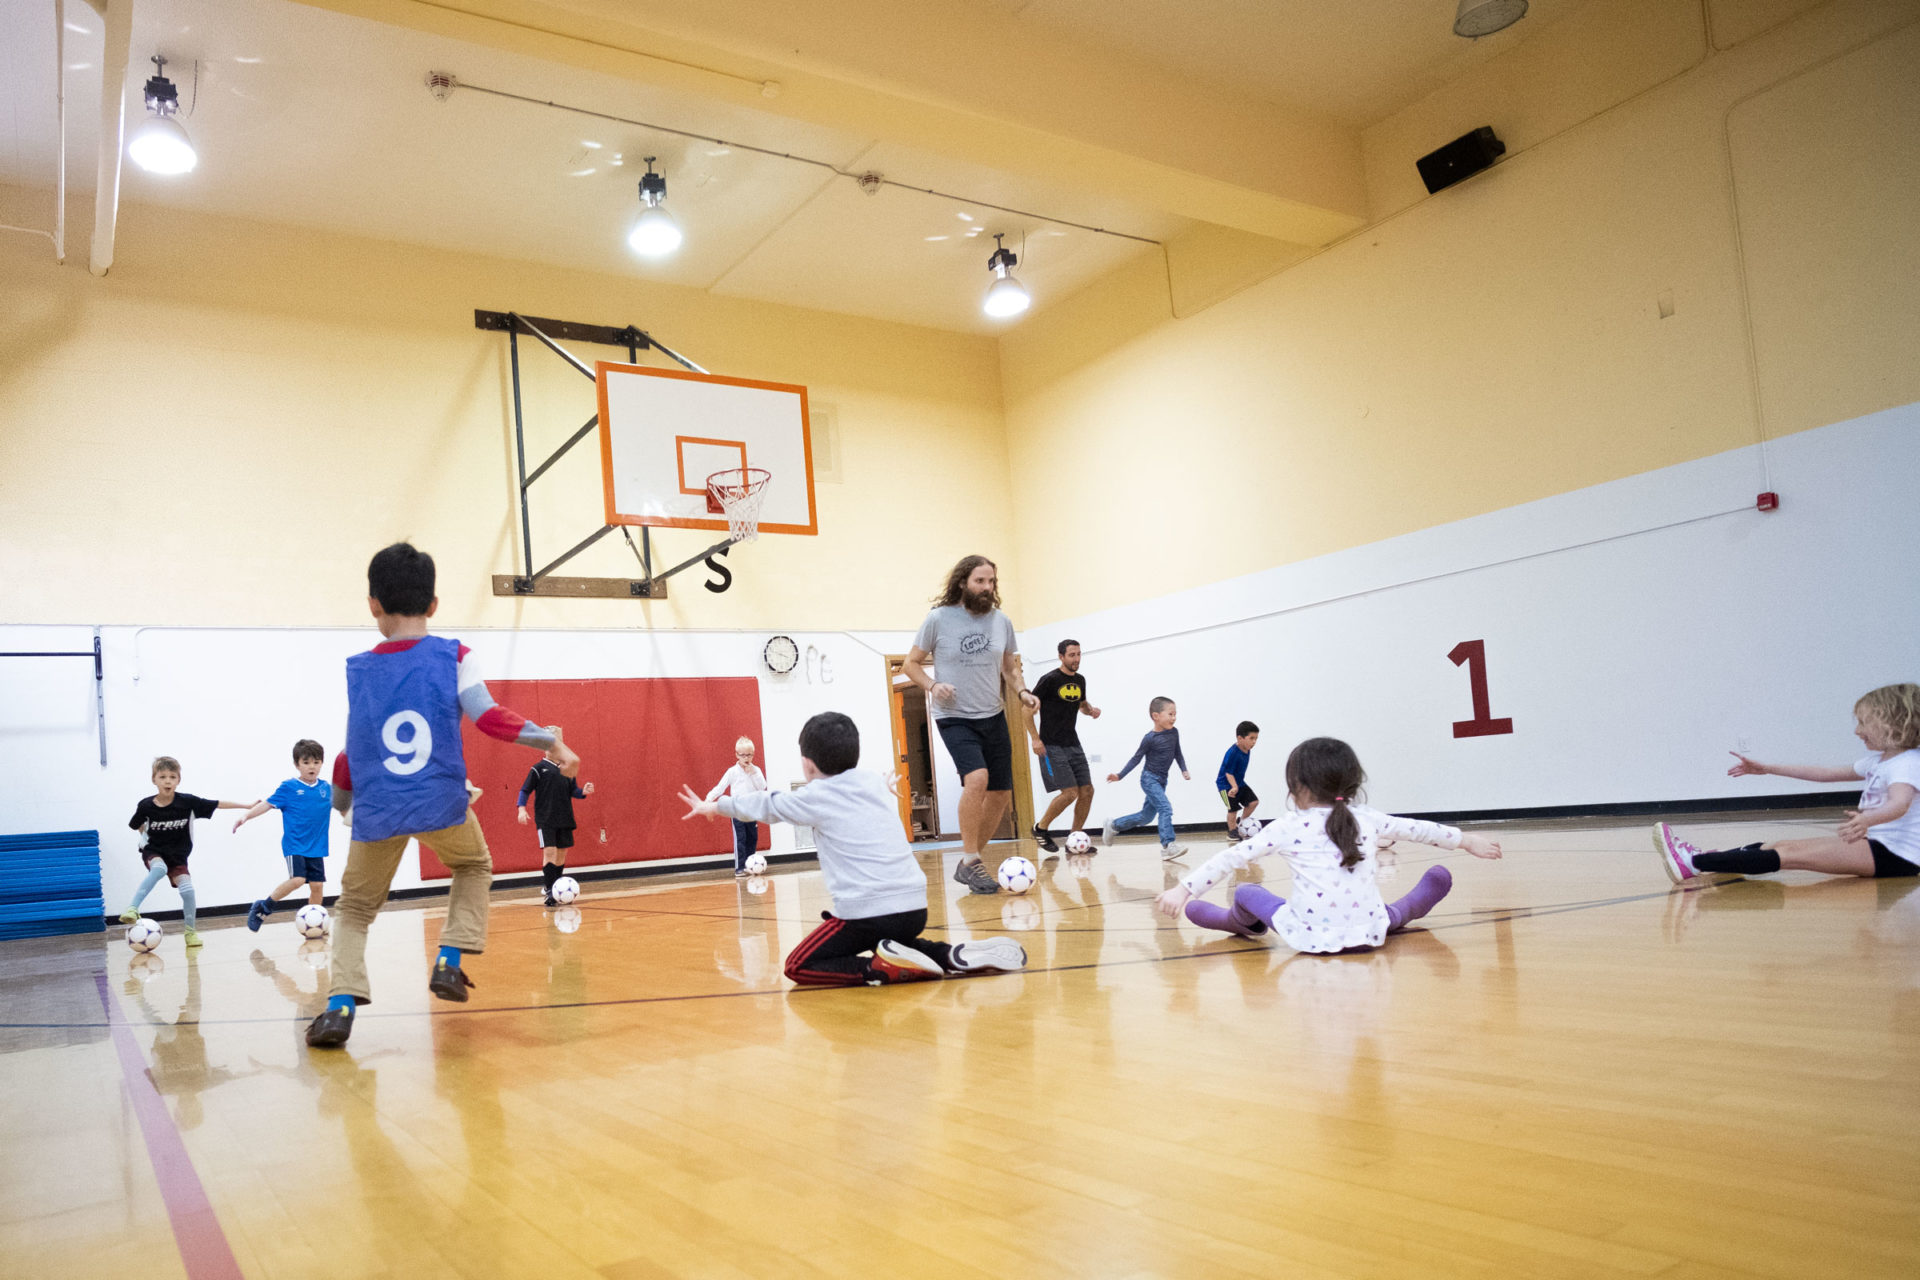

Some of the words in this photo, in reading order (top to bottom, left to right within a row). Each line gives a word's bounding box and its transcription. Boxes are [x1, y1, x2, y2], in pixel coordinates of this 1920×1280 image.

[704, 546, 732, 594] S
[1446, 639, 1514, 739] 1
[382, 709, 433, 776] 9
